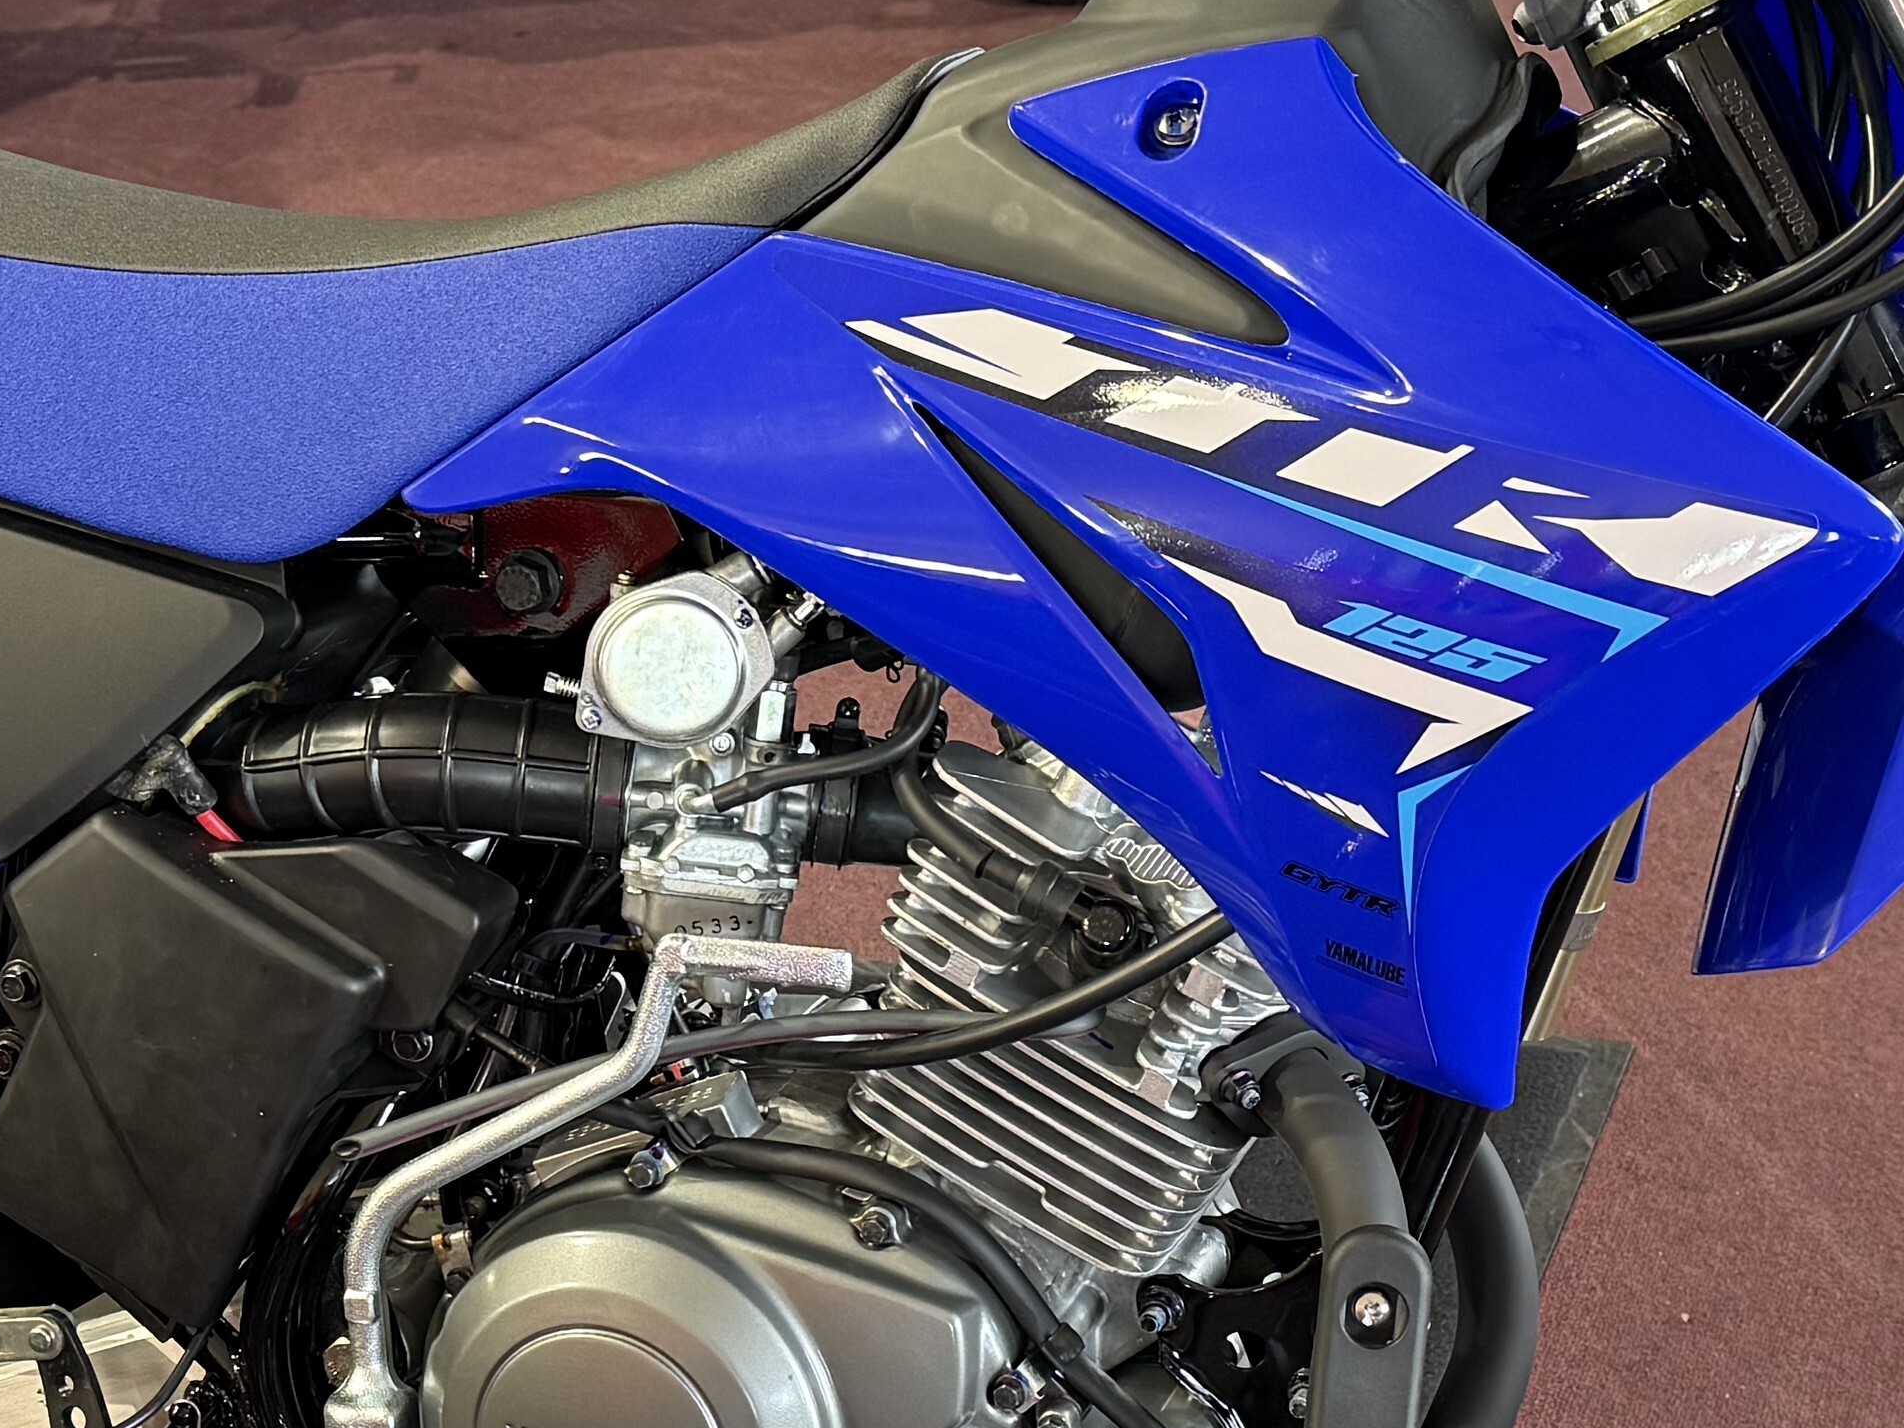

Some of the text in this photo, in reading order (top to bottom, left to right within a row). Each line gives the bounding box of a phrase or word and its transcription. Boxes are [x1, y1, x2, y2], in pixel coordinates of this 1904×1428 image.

[1322, 600, 1549, 683] 125
[1280, 861, 1404, 919] GYTR
[1323, 938, 1407, 986] YAMALUBE
